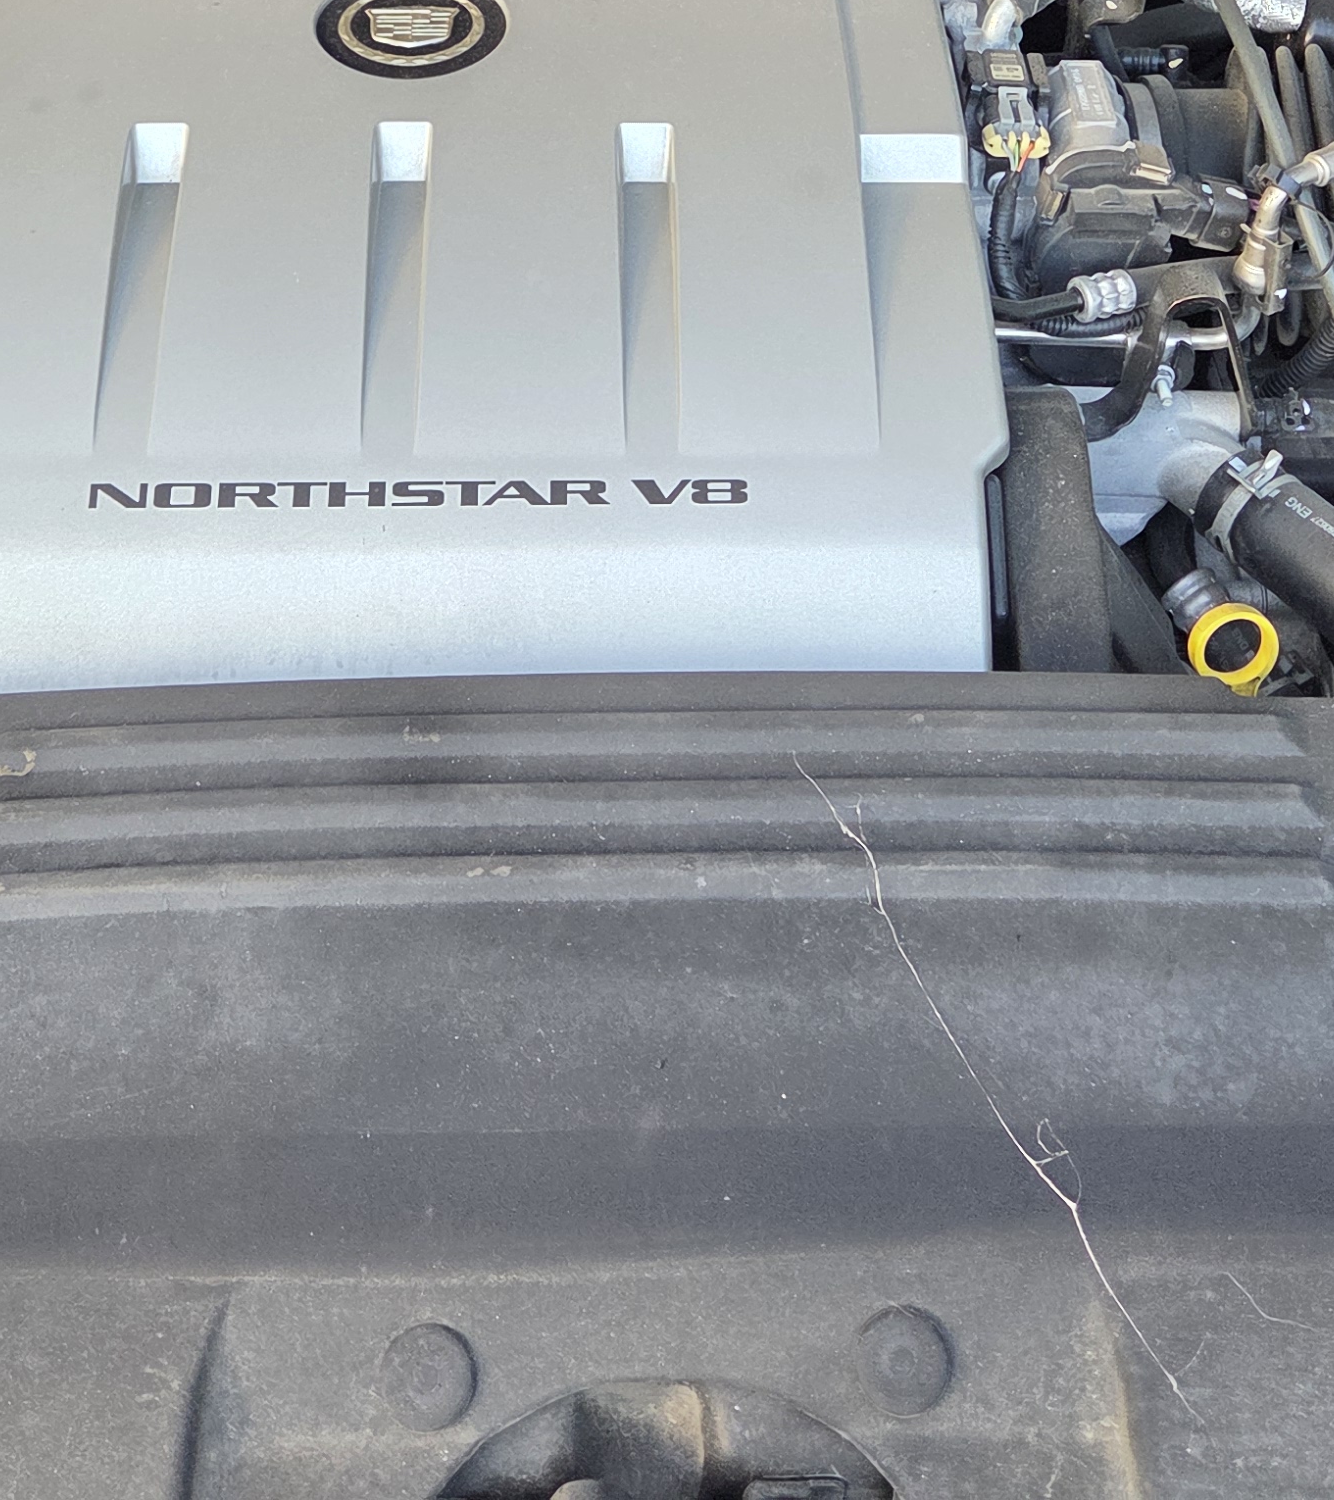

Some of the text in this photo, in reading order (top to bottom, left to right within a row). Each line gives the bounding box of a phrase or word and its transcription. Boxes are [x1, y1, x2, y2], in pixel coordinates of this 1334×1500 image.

[87, 478, 750, 509] NORTHSTAR V8
[1285, 497, 1313, 518] ENG
